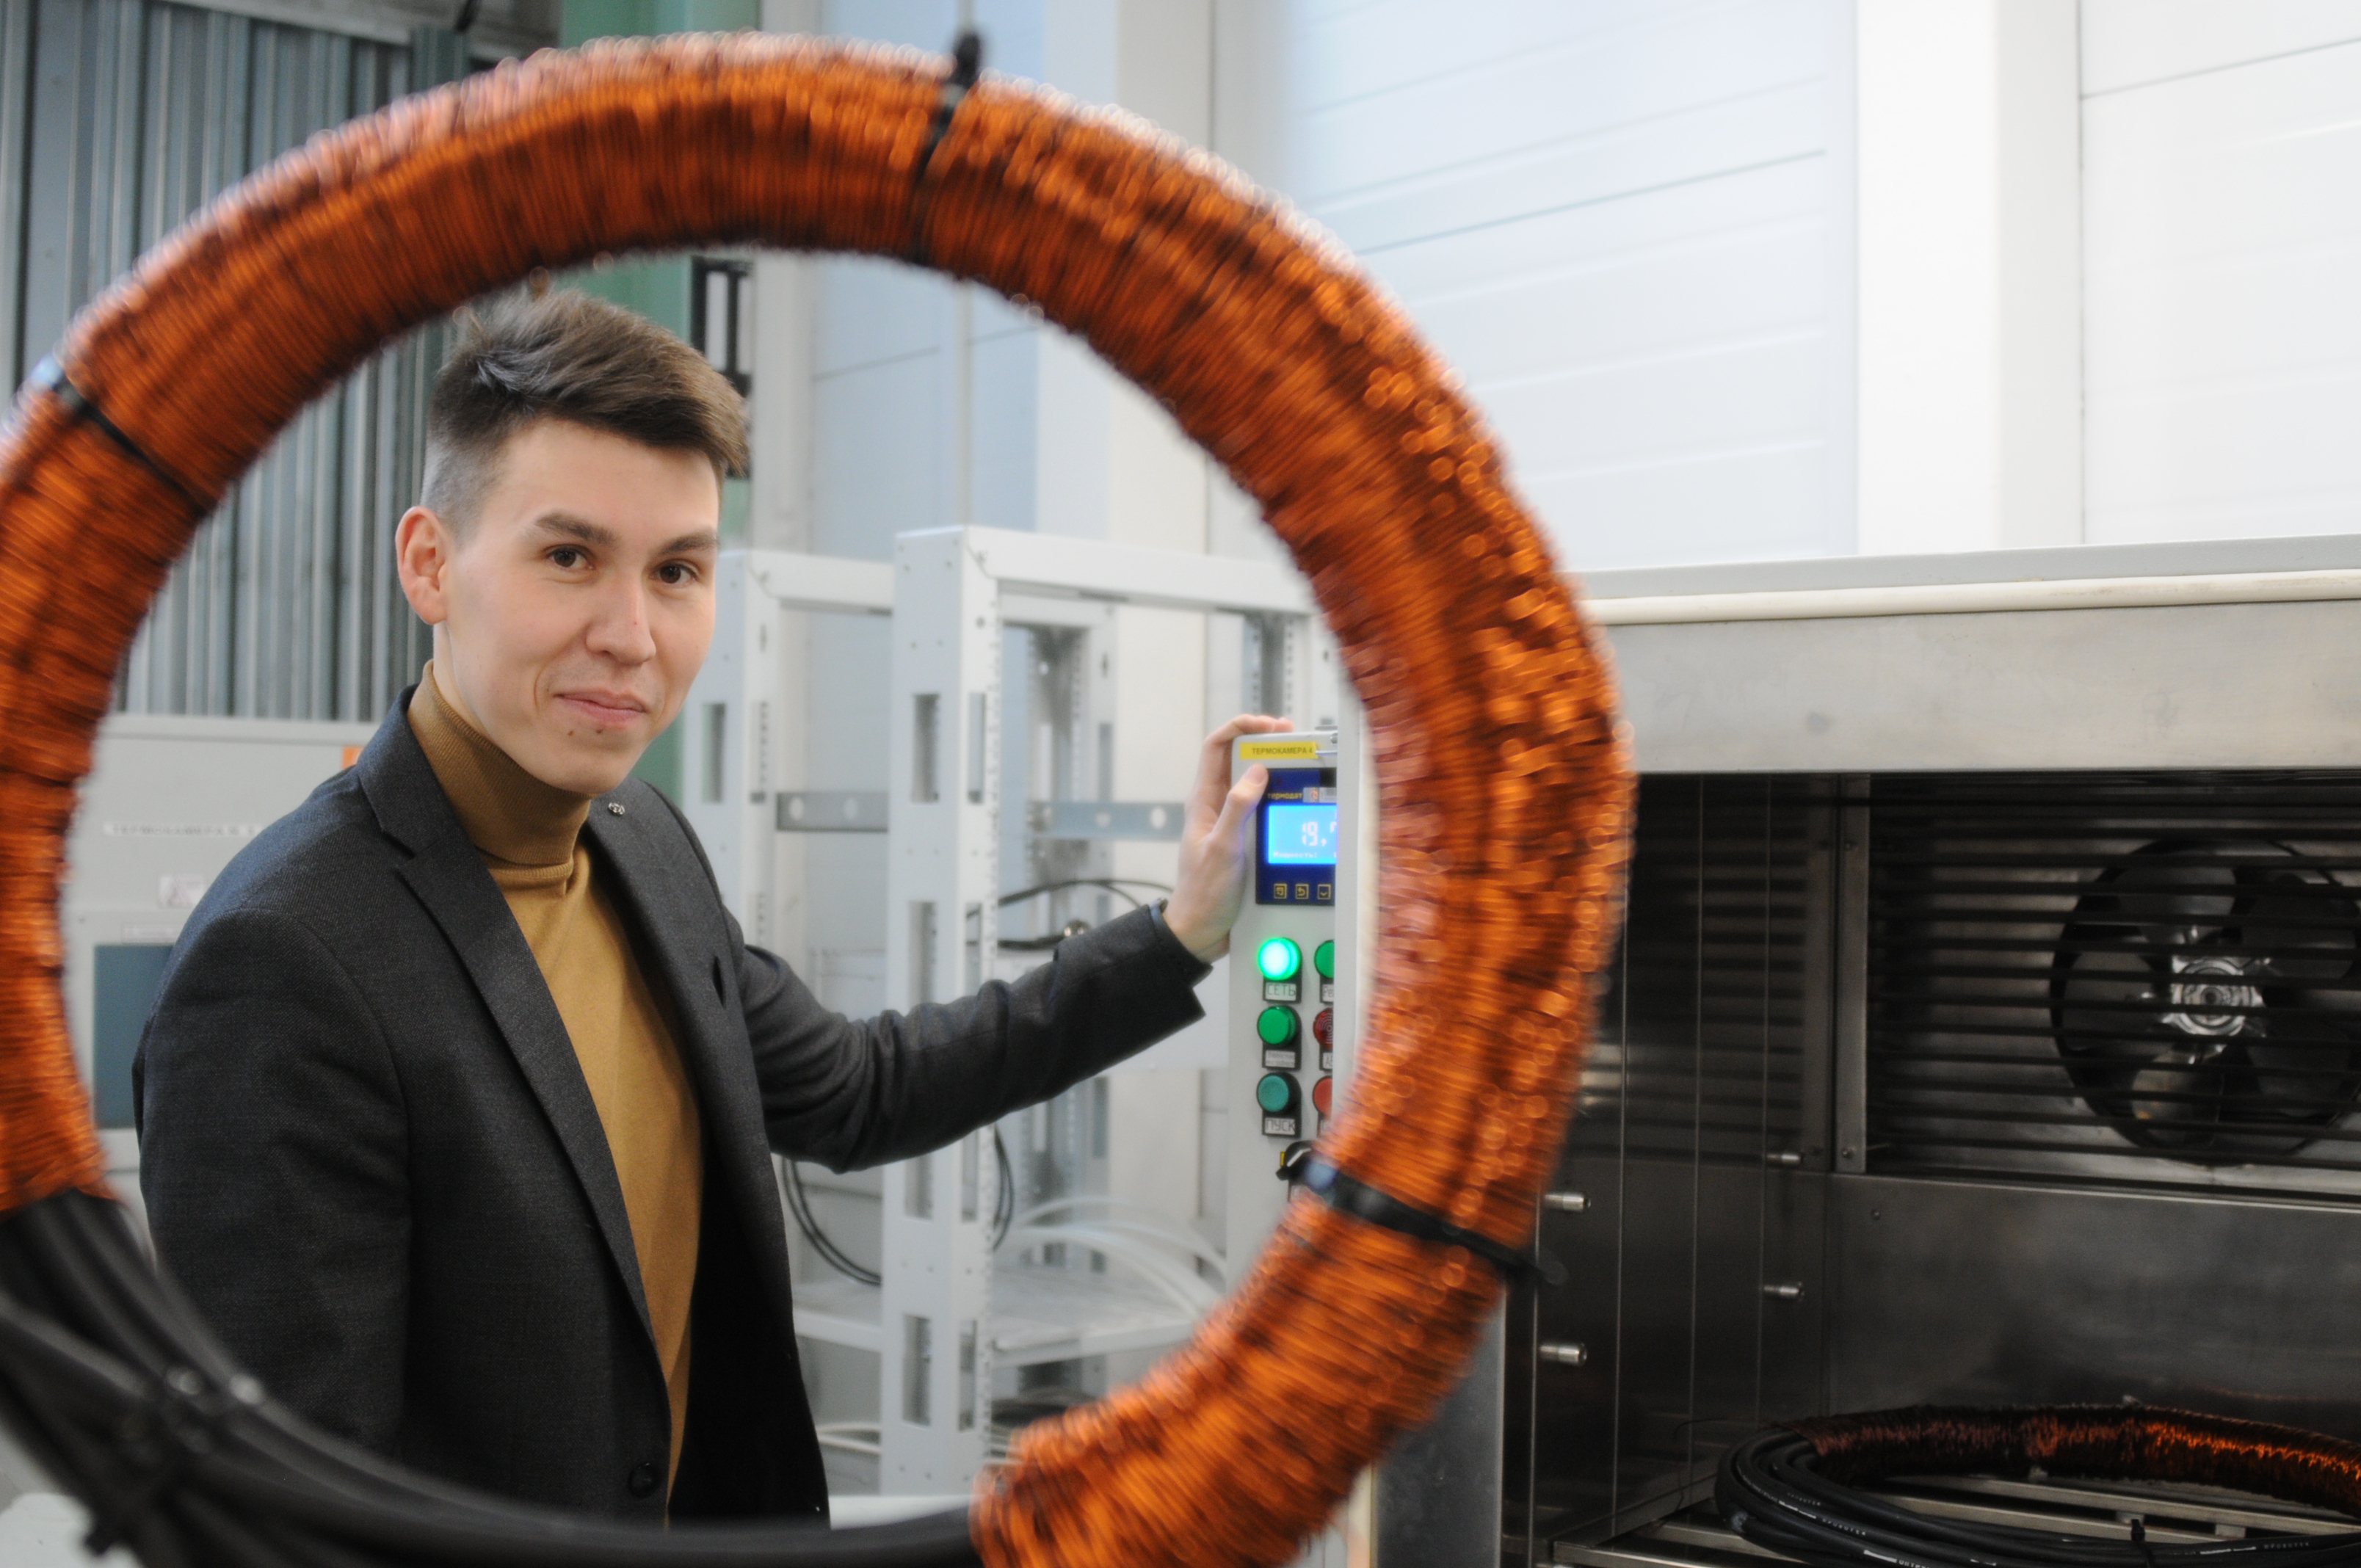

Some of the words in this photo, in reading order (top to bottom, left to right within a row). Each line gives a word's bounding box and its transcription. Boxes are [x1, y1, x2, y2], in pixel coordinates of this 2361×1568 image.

[1252, 747, 1307, 755] ТЕРМОКАМЕРА
[1267, 982, 1296, 997] СЕТЬ
[1265, 1119, 1296, 1132] ПУСК
